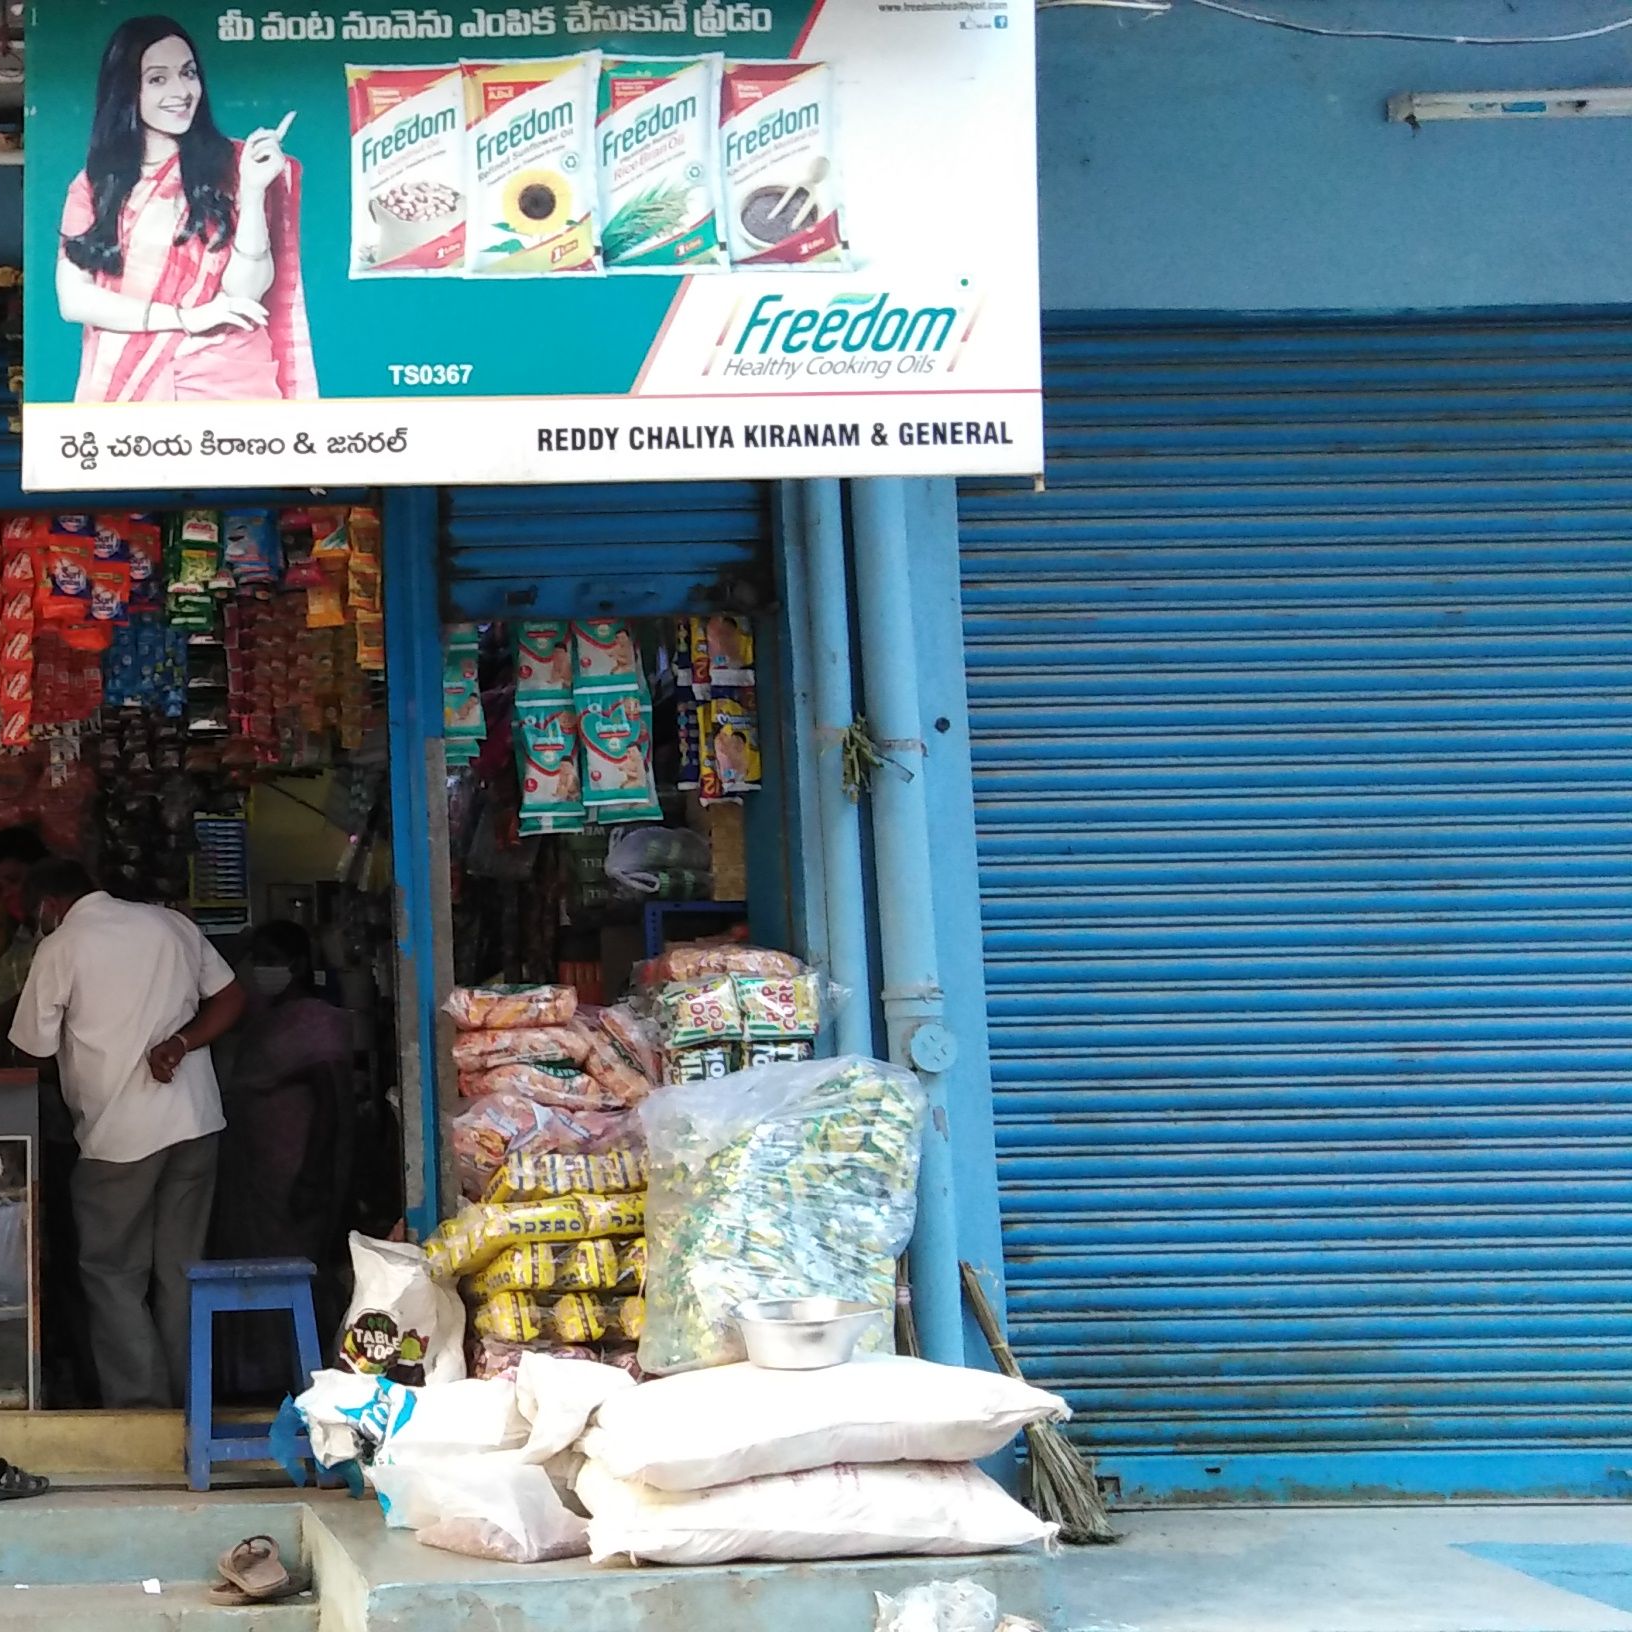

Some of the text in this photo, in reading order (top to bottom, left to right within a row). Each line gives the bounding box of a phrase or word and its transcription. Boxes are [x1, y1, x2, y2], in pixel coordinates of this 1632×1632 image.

[218, 10, 254, 41] మీ
[260, 13, 335, 41] వంట
[342, 11, 452, 41] నూనెను
[460, 8, 555, 38] ఎంపిక
[565, 1, 687, 38] చేసుకునే
[362, 107, 457, 174] Freedom
[476, 100, 574, 171] Freedom
[602, 95, 697, 168] Freedom
[726, 102, 820, 168] Freedom
[734, 292, 957, 355] Freedom
[388, 364, 474, 386] TS0367
[723, 354, 936, 380] Healthy Cooking Oils
[60, 427, 409, 471] రెడ్డి చలియ కిరాణం & జనరల్
[537, 421, 1014, 452] REDDY CHALIYA KIRANAM & GENERAL
[508, 1218, 583, 1236] JUMBO
[352, 1327, 402, 1352] TABLE
[363, 1342, 396, 1361] TOP
